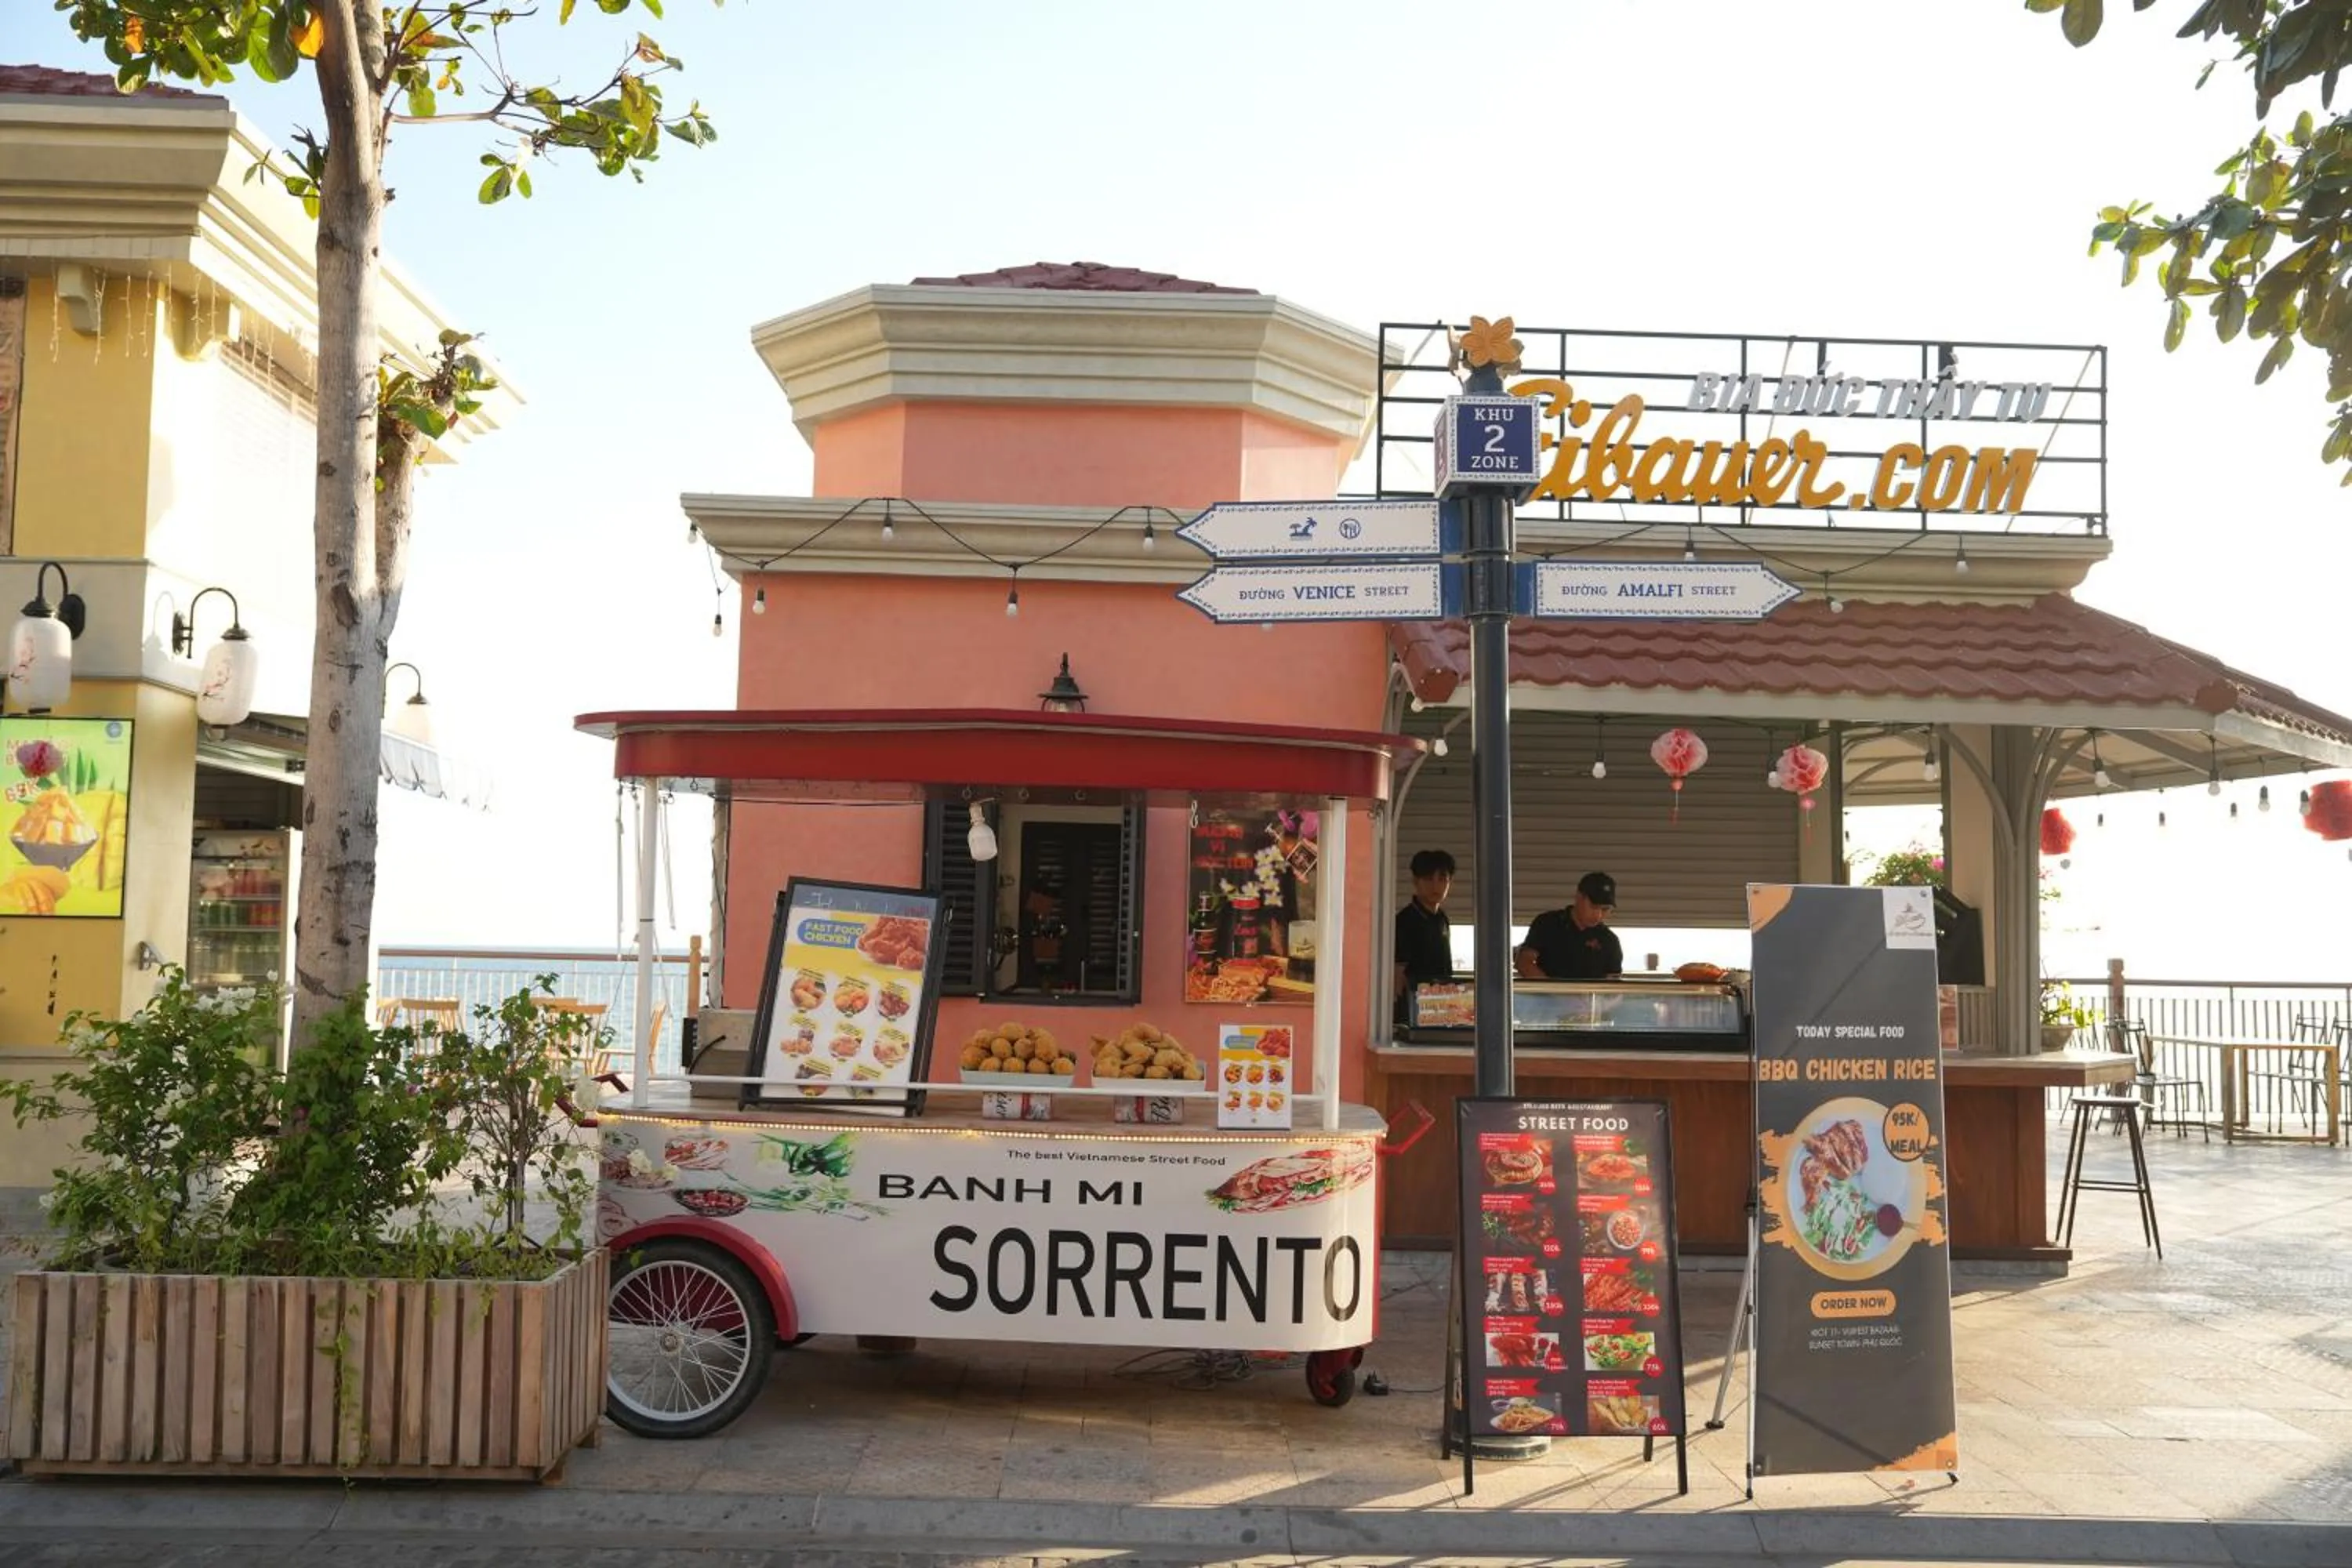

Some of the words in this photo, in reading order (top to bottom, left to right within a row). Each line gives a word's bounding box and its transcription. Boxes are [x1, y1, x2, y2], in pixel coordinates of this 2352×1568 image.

[1686, 371, 1764, 413] BIA
[1772, 361, 1866, 418] ĐỨC
[1995, 381, 2053, 423] TU
[1474, 408, 1514, 421] KHU
[1484, 424, 1505, 452] 2
[1471, 456, 1519, 469] ZONE
[1239, 586, 1285, 600] ĐƯỜNG
[1293, 586, 1356, 600] VENICE
[1364, 586, 1410, 597] STREET
[1561, 584, 1608, 596] ĐƯỜNG
[1617, 583, 1683, 597] AMALFI
[1690, 586, 1737, 596] STREET
[804, 921, 833, 933] FAST
[833, 924, 864, 935] FOOD
[804, 931, 851, 944] CHICKEN
[1796, 1025, 1831, 1038] TODAY
[1835, 1025, 1877, 1038] SPECIAL
[1879, 1026, 1905, 1038] FOOD
[1759, 1058, 1798, 1081] BBQ
[1806, 1058, 1888, 1080] CHICKEN
[1893, 1058, 1936, 1080] RICE
[1518, 1116, 1577, 1130] STREET
[1583, 1116, 1629, 1131] FOOD
[1890, 1138, 1925, 1153] MEAL
[1007, 1150, 1031, 1160] The
[1035, 1151, 1063, 1160] best
[1066, 1152, 1145, 1163] Vietnamese
[1149, 1154, 1189, 1164] Street
[1193, 1156, 1226, 1166] Food
[878, 1173, 1051, 1203] BANH
[1078, 1180, 1142, 1206] MI
[929, 1225, 1361, 1325] SORRENTO
[1820, 1298, 1857, 1309] ORDER
[1860, 1297, 1887, 1308] NOW
